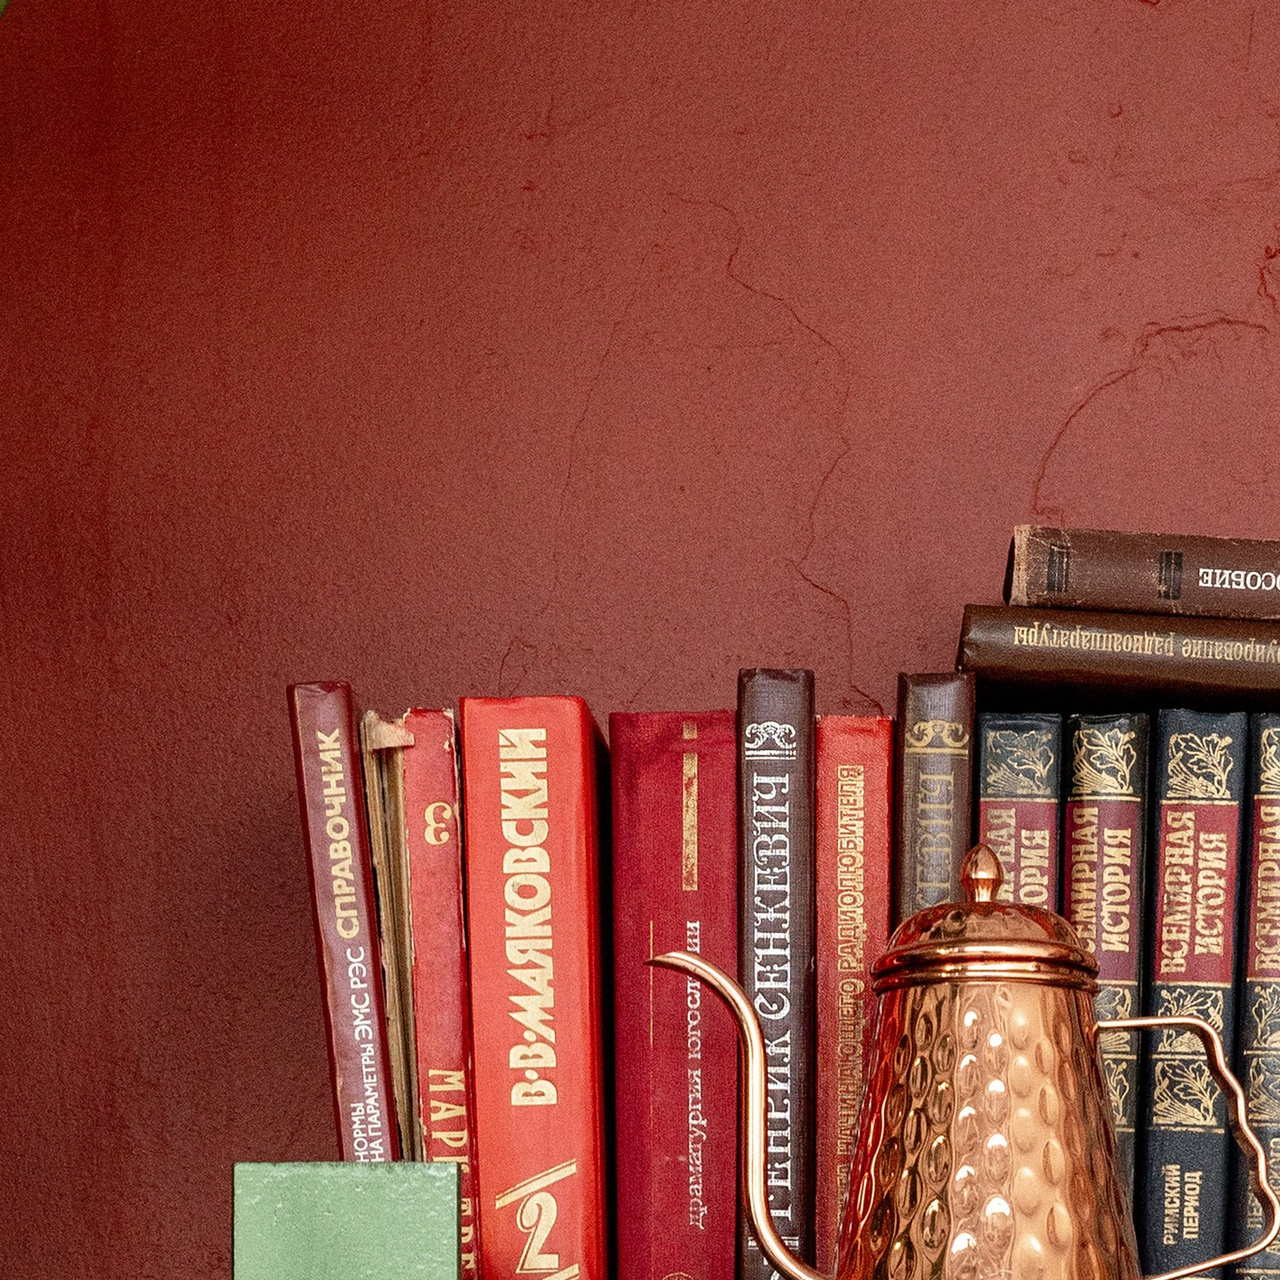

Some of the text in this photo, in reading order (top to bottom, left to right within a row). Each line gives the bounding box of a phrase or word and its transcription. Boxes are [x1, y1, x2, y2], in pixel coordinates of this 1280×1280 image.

[1013, 624, 1175, 657] радиоаппаратуры
[317, 728, 360, 939] СПРАВОЧНИК
[752, 772, 791, 1020] СЕНКЕВИЧ
[837, 764, 864, 972] РАДИОЛЮБИТЕЛЯ
[1102, 827, 1132, 953] ИСТОРИЯ
[1160, 811, 1196, 974] ВСЕМИРНАЯ
[1195, 832, 1228, 956] ИСТОРИЯ
[685, 920, 702, 1059] югослии
[346, 947, 386, 1163] НА ПАРАМЕТРЫ ЭМС РЭС
[352, 1101, 369, 1162] НОРМЫ
[515, 1190, 559, 1275] 2
[1162, 1164, 1182, 1245] РИМСКИЙ
[1183, 1169, 1203, 1240] ПЕРИОД
